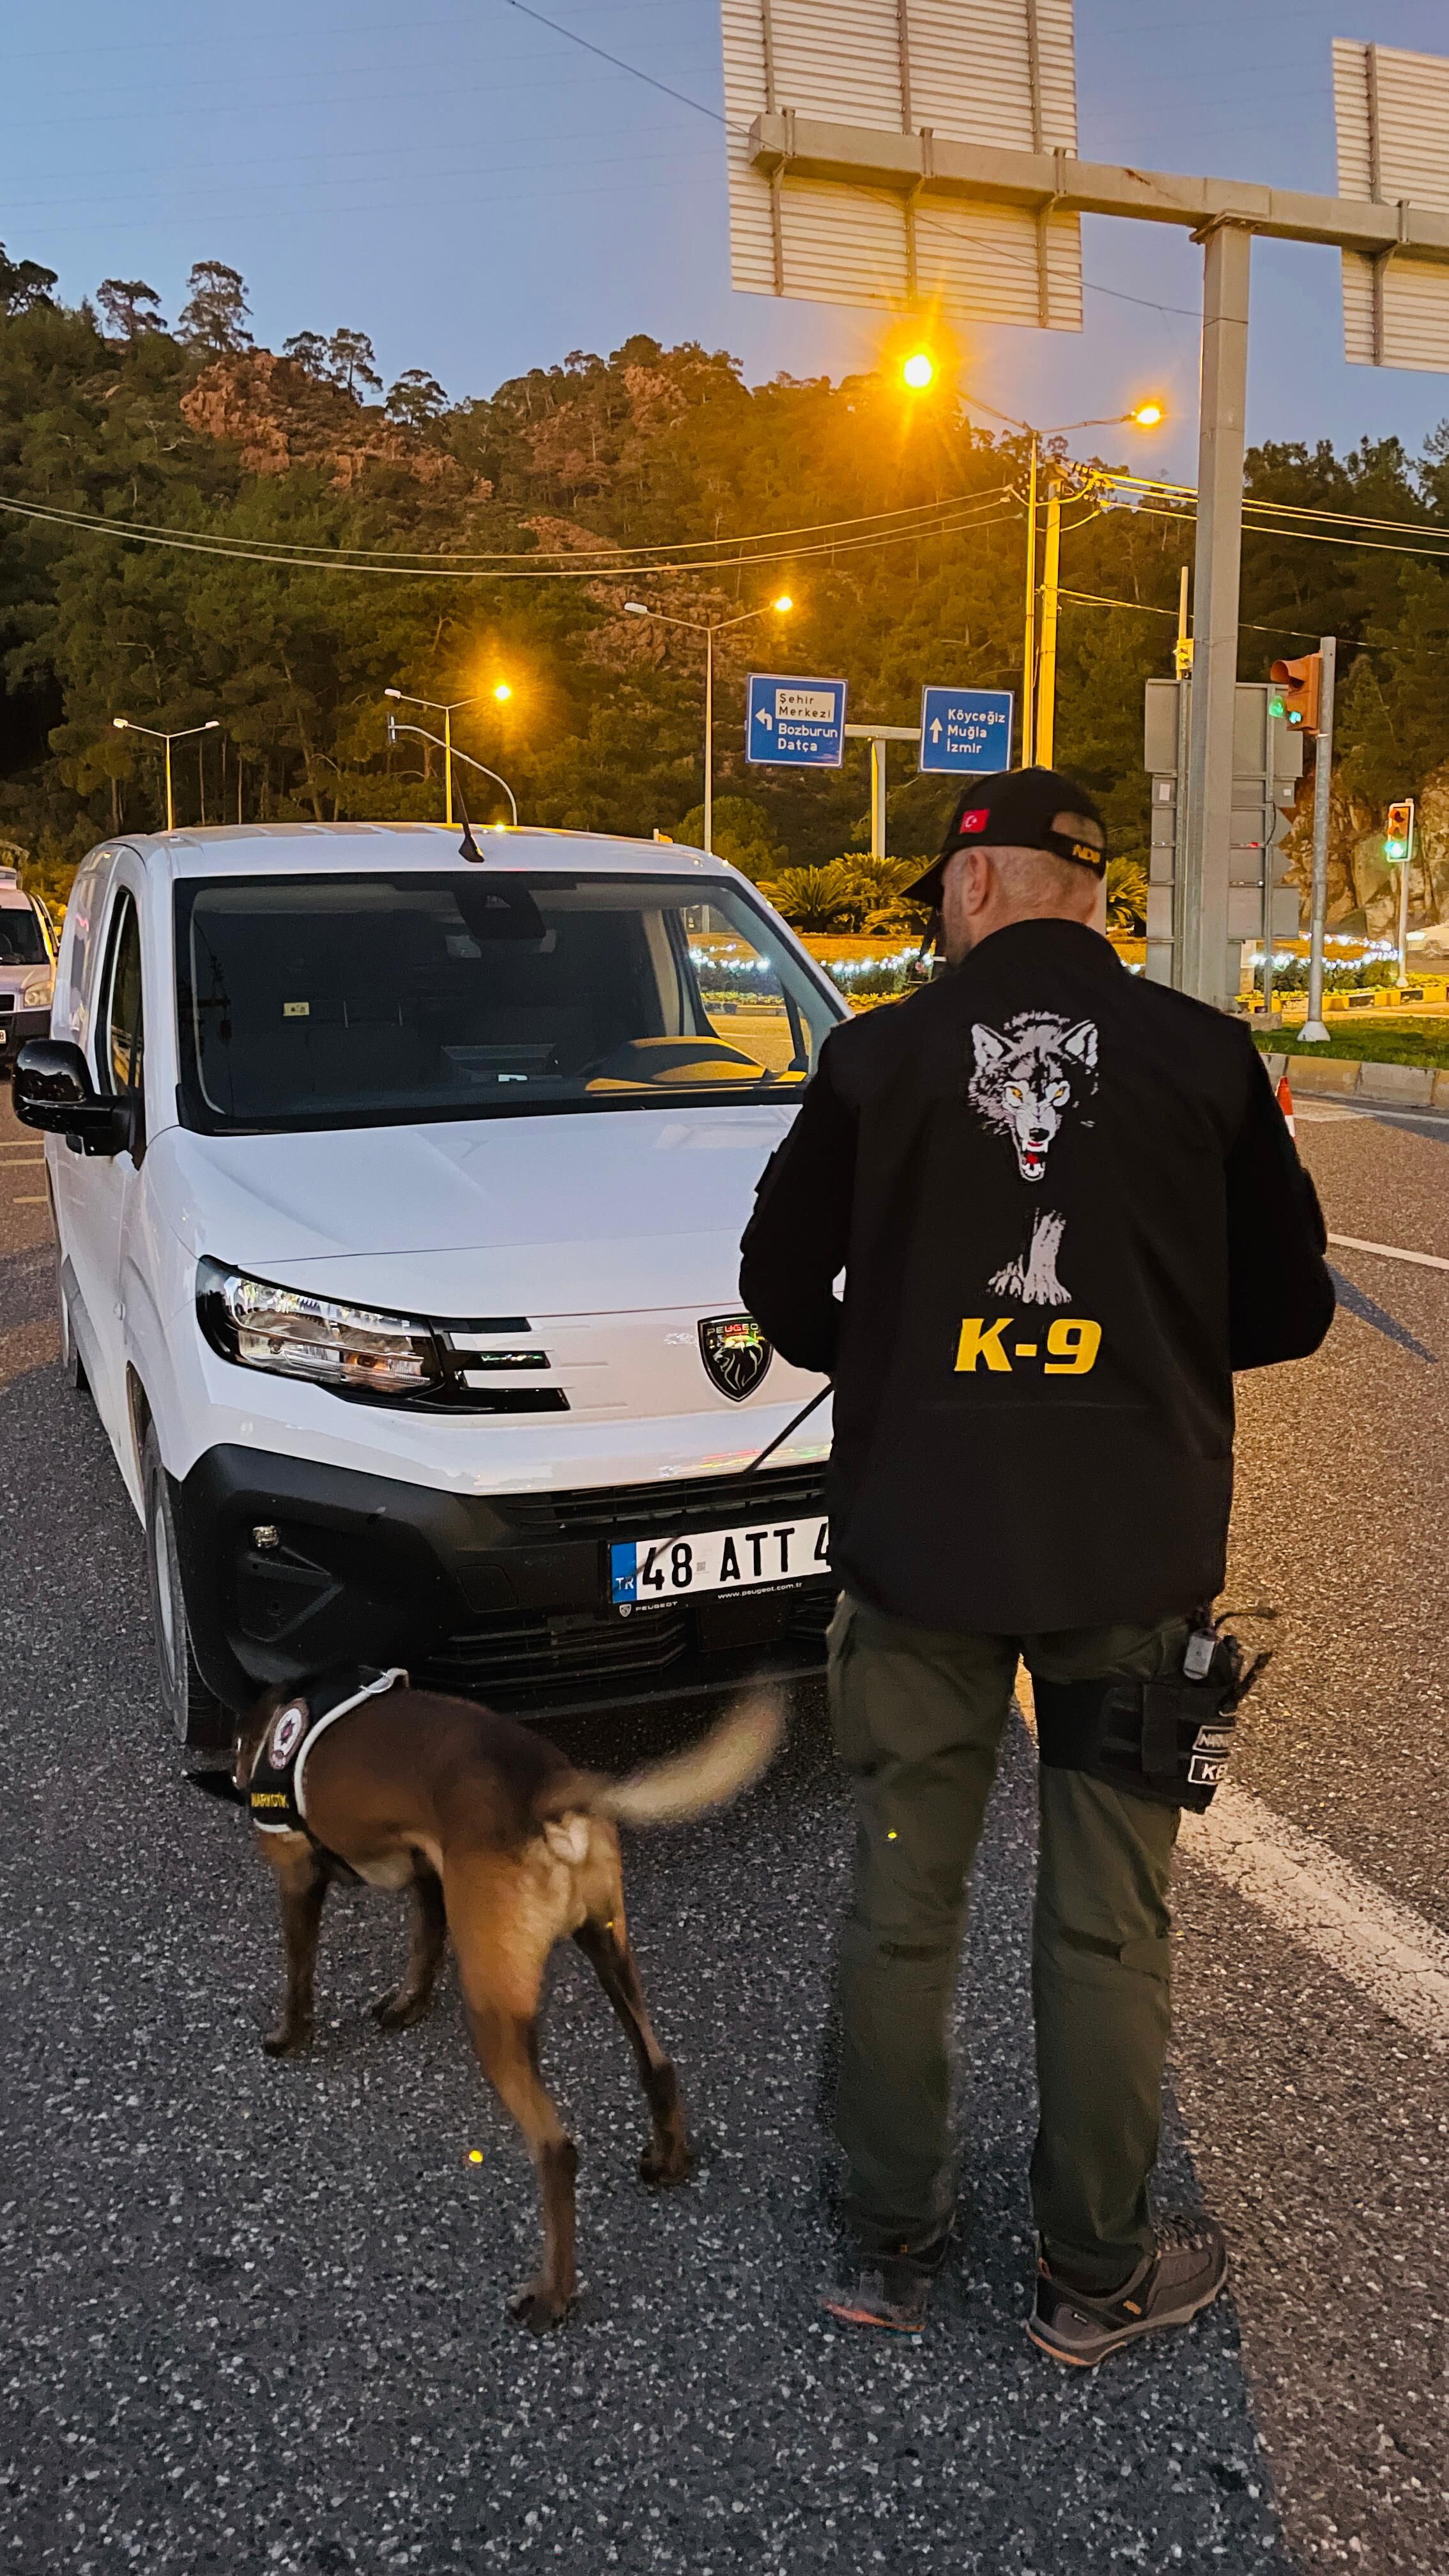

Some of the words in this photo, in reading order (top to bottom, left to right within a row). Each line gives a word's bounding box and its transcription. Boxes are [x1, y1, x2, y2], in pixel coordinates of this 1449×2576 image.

[779, 693, 815, 705] Şehir
[779, 706, 831, 719] Merkezi
[947, 709, 1006, 725] Köyceğiz
[778, 723, 838, 738] Bozburun
[947, 724, 987, 740] Muğla
[778, 737, 818, 753] Datça
[947, 738, 983, 753] İzmir
[707, 1322, 759, 1336] PEUGEO
[953, 1318, 1102, 1374] K-9
[642, 1542, 693, 1591] 48
[719, 1528, 795, 1582] ATT
[717, 1581, 802, 1599] www.peugeot.com.tr
[635, 1601, 678, 1612] PEUGEOT
